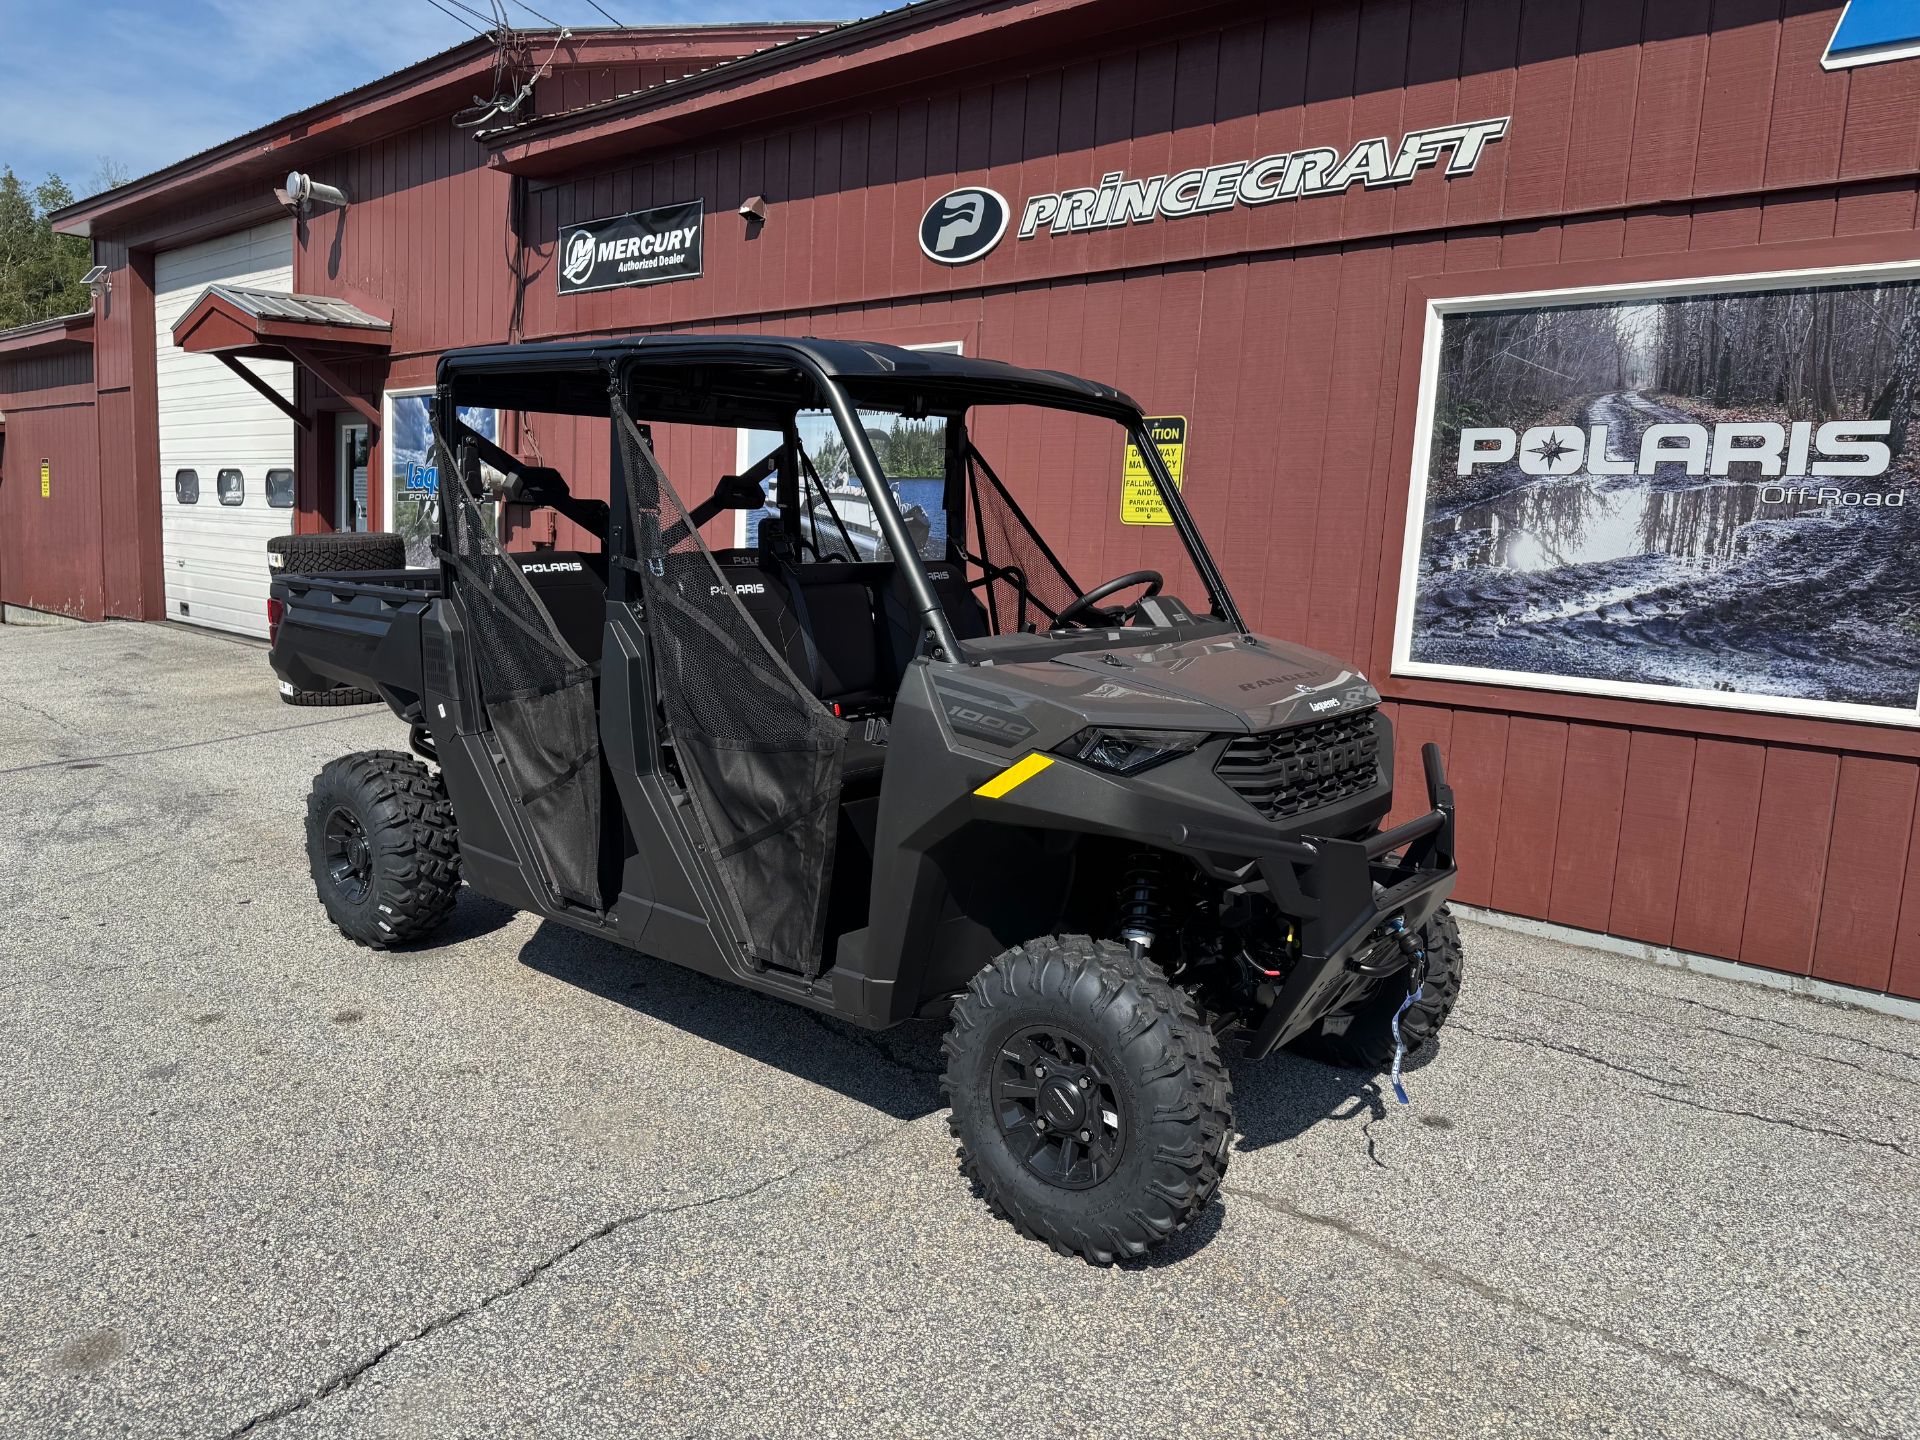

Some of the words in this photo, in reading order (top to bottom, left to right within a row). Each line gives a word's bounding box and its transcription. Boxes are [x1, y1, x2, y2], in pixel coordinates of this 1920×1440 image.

[597, 225, 698, 262] MERCURY
[617, 257, 658, 272] Authorized
[658, 253, 685, 266] Dealer
[1456, 419, 1892, 477] POLARIS
[1761, 486, 1905, 507] Off-Road
[521, 562, 583, 574] POLARIS
[1238, 670, 1321, 692] RANGER
[948, 705, 1032, 736] 1000
